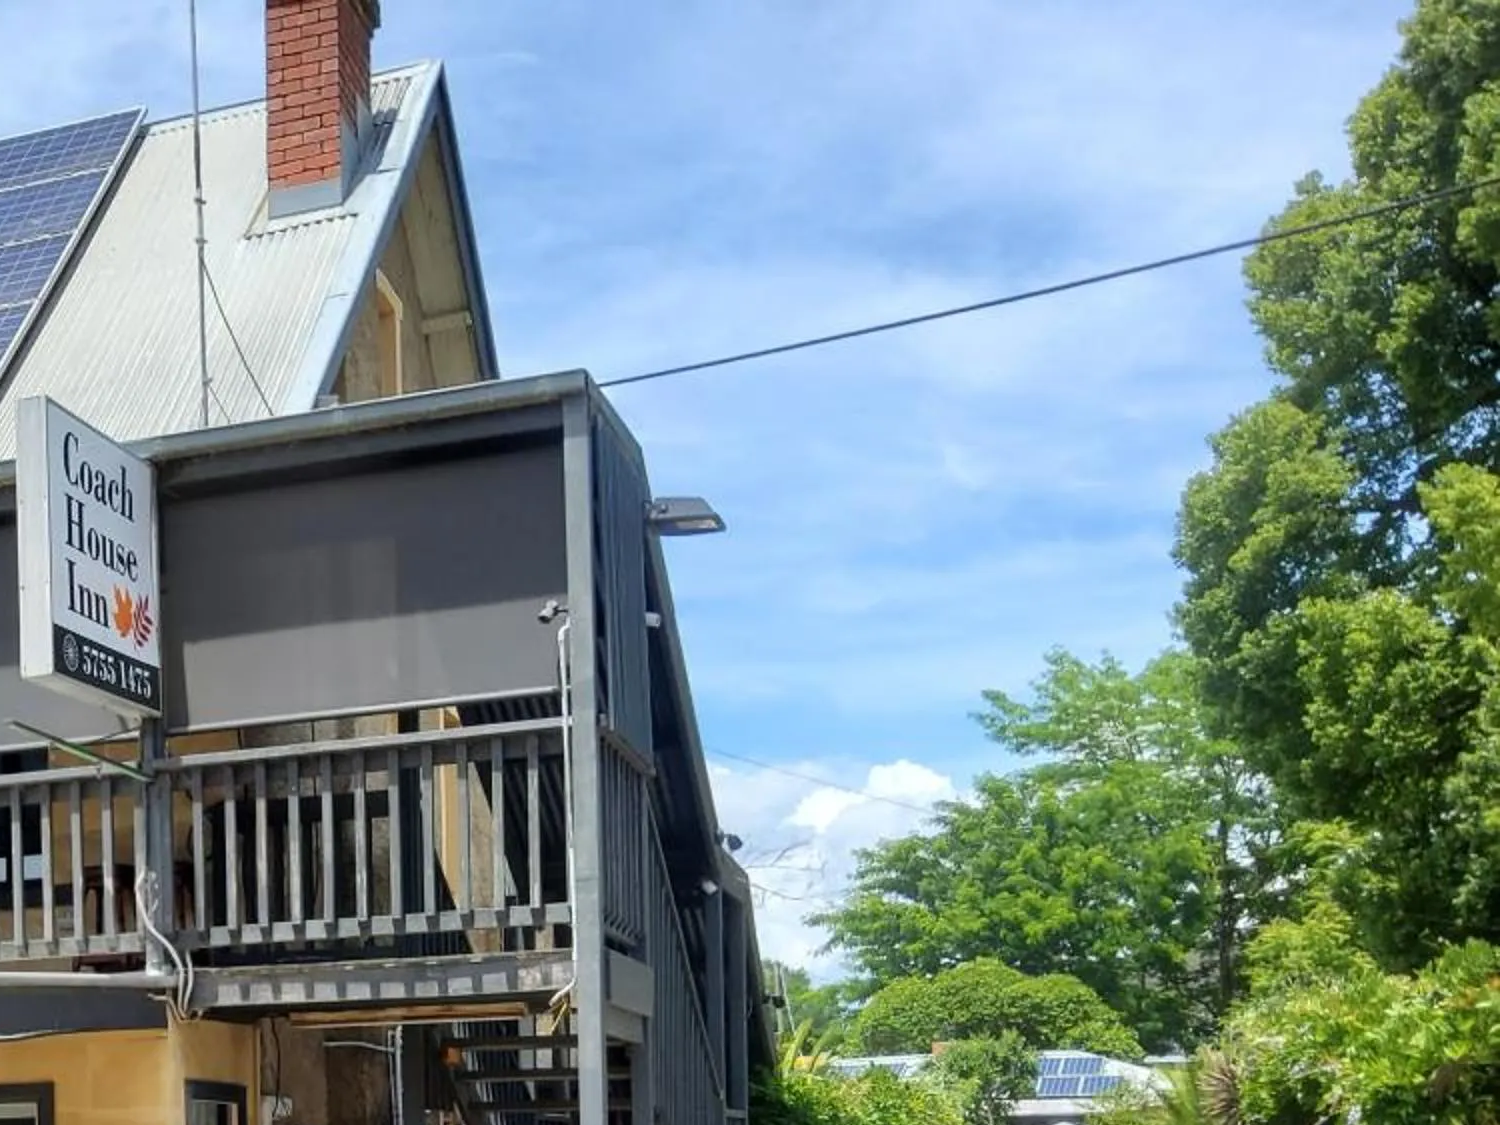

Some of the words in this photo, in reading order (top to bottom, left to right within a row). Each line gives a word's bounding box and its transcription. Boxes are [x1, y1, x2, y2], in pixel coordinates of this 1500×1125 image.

[63, 431, 135, 522] Coach
[64, 493, 139, 581] House
[65, 557, 110, 628] Inn
[82, 645, 116, 685] 5755
[118, 660, 152, 699] 1475
